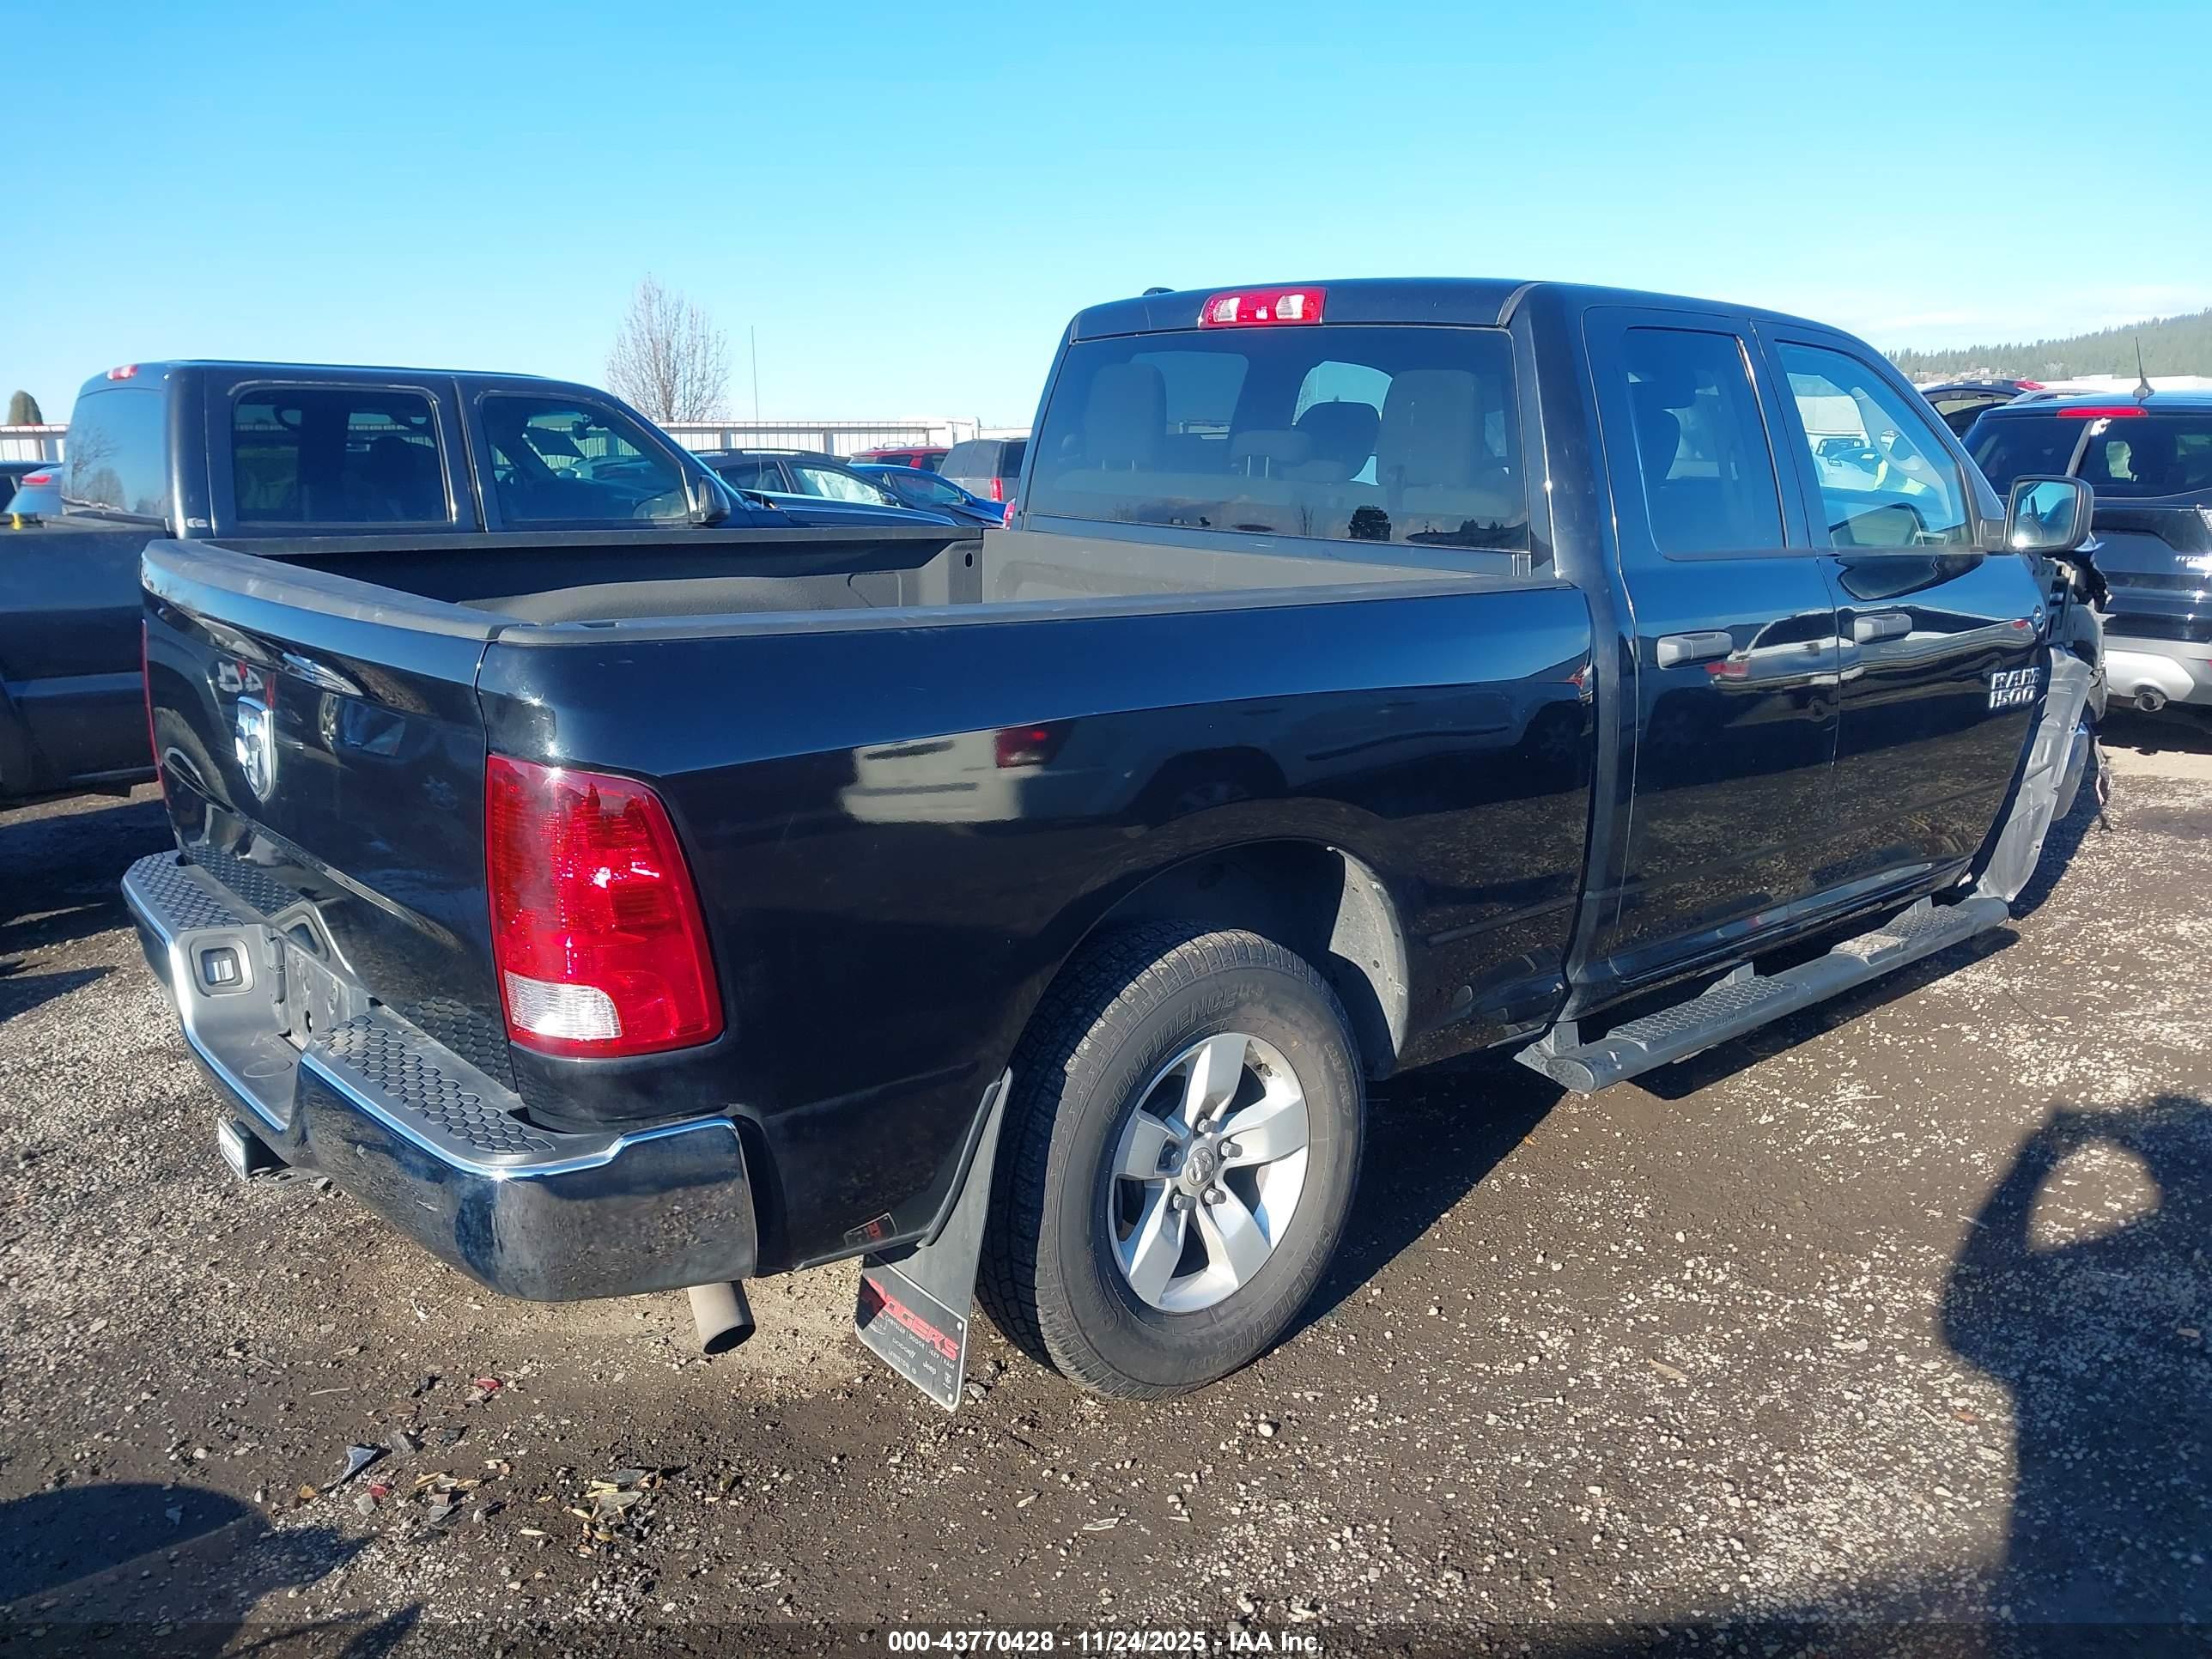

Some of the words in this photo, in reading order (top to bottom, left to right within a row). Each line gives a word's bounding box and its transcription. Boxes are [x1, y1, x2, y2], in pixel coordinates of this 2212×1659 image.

[1990, 667, 2041, 690] RAM
[1988, 685, 2038, 709] 1500
[1103, 988, 1239, 1123] CONFIDENCE
[922, 1359, 938, 1376] Jeep
[928, 1346, 940, 1360] JEEP
[943, 1358, 956, 1370] RAM
